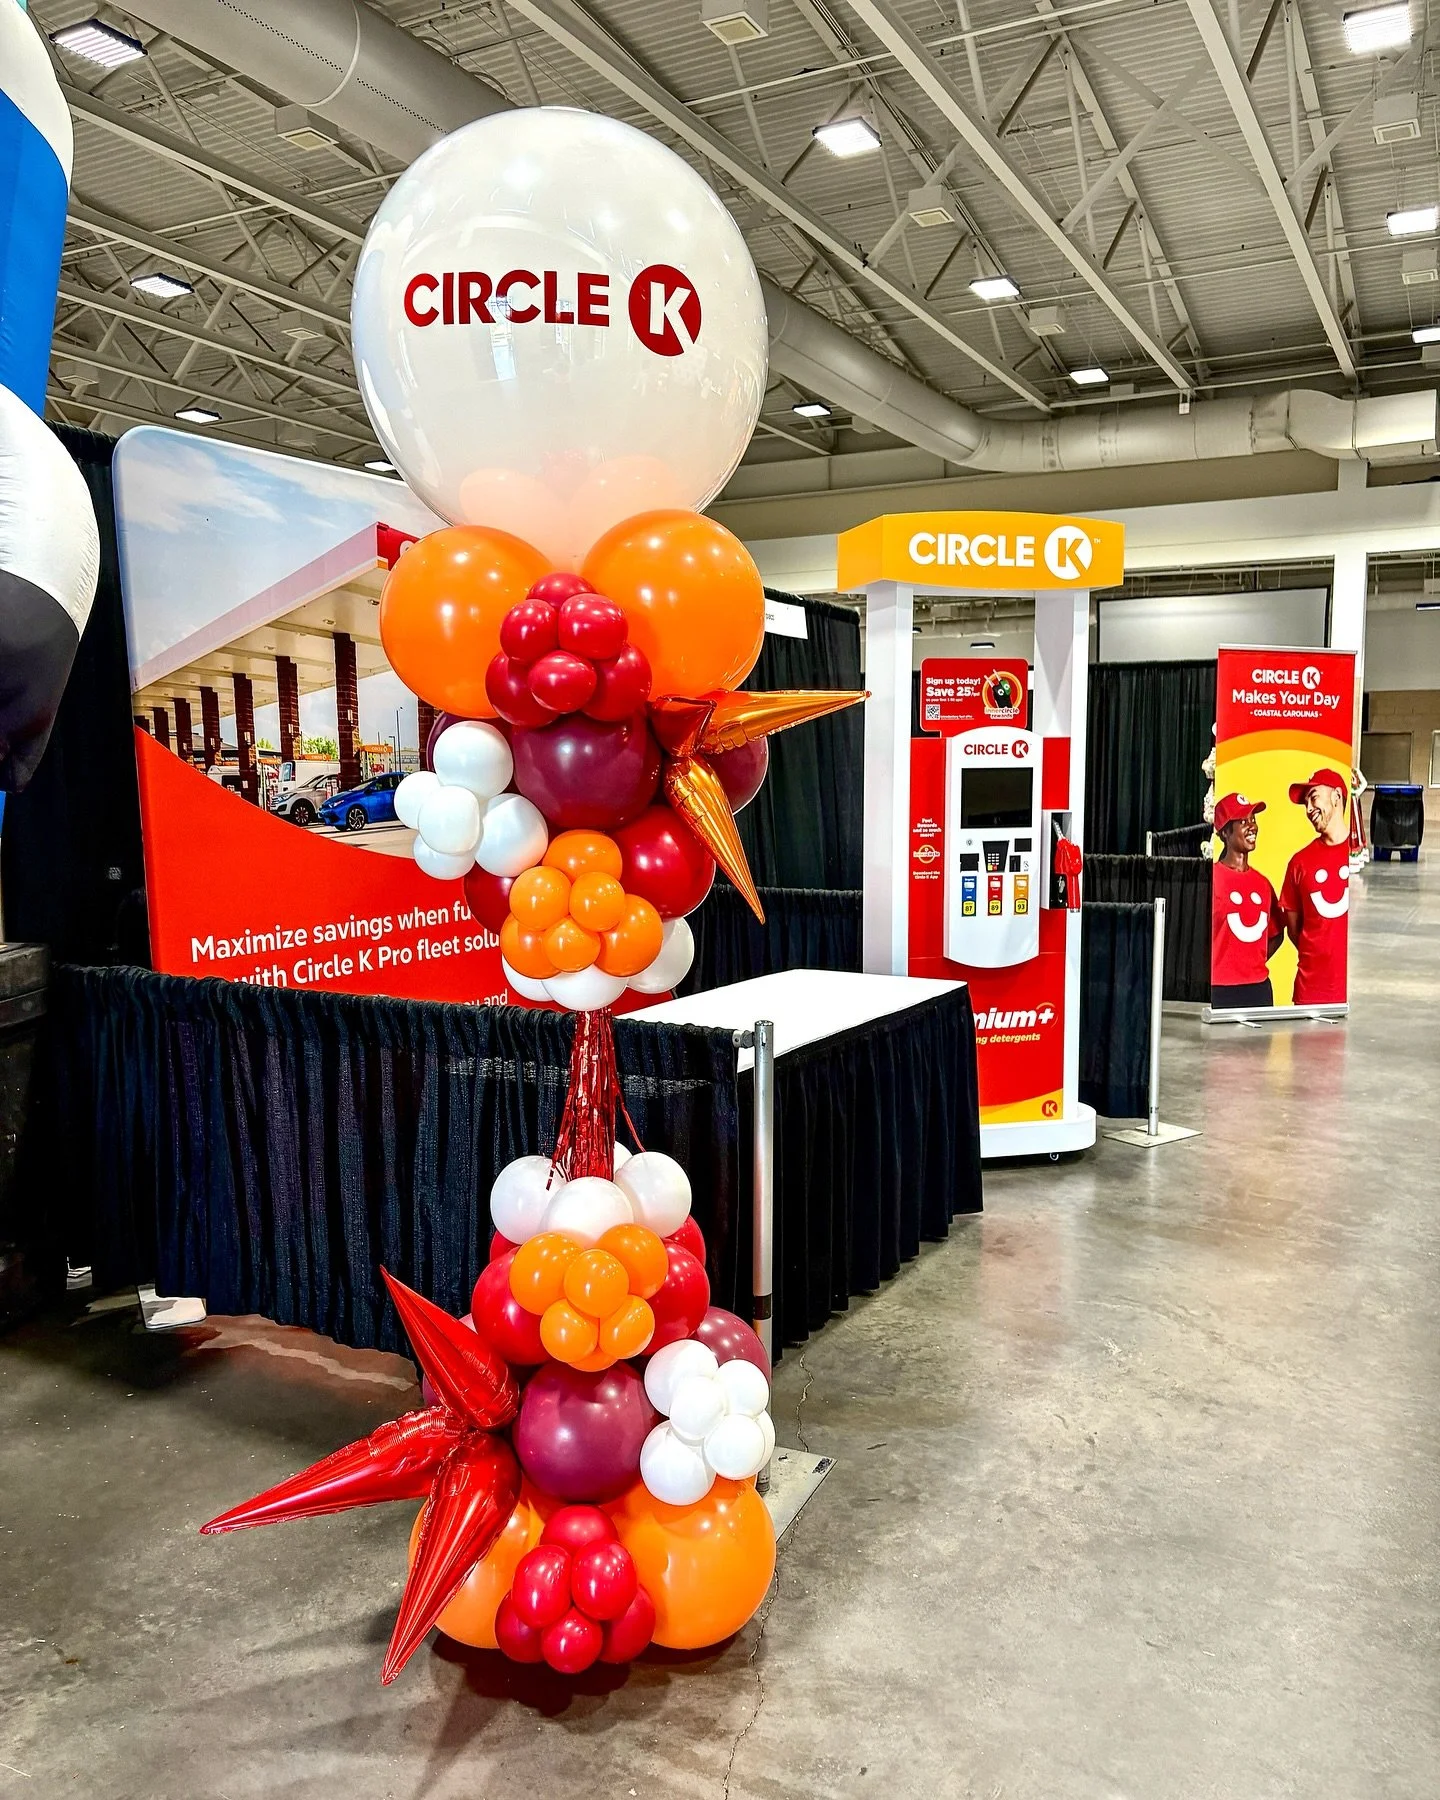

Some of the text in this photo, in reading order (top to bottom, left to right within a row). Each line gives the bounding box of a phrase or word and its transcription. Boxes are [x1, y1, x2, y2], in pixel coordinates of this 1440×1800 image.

[404, 269, 610, 328] CIRCLE
[908, 532, 1035, 568] CIRCLE
[926, 677, 981, 686] Sign up today!
[1251, 668, 1300, 685] CIRCLE
[926, 686, 955, 697] Save
[1232, 688, 1340, 710] Makes Your Day
[1253, 709, 1319, 718] COASTAL CAROLINAS
[963, 743, 1009, 756] CIRCLE
[190, 924, 307, 963] Maximize
[313, 914, 393, 945] savings
[397, 907, 450, 931] when
[293, 954, 354, 984] Circle
[358, 950, 374, 972] K
[378, 944, 413, 967] Pro
[416, 936, 461, 962] fleet
[989, 1032, 1041, 1044] detergents
